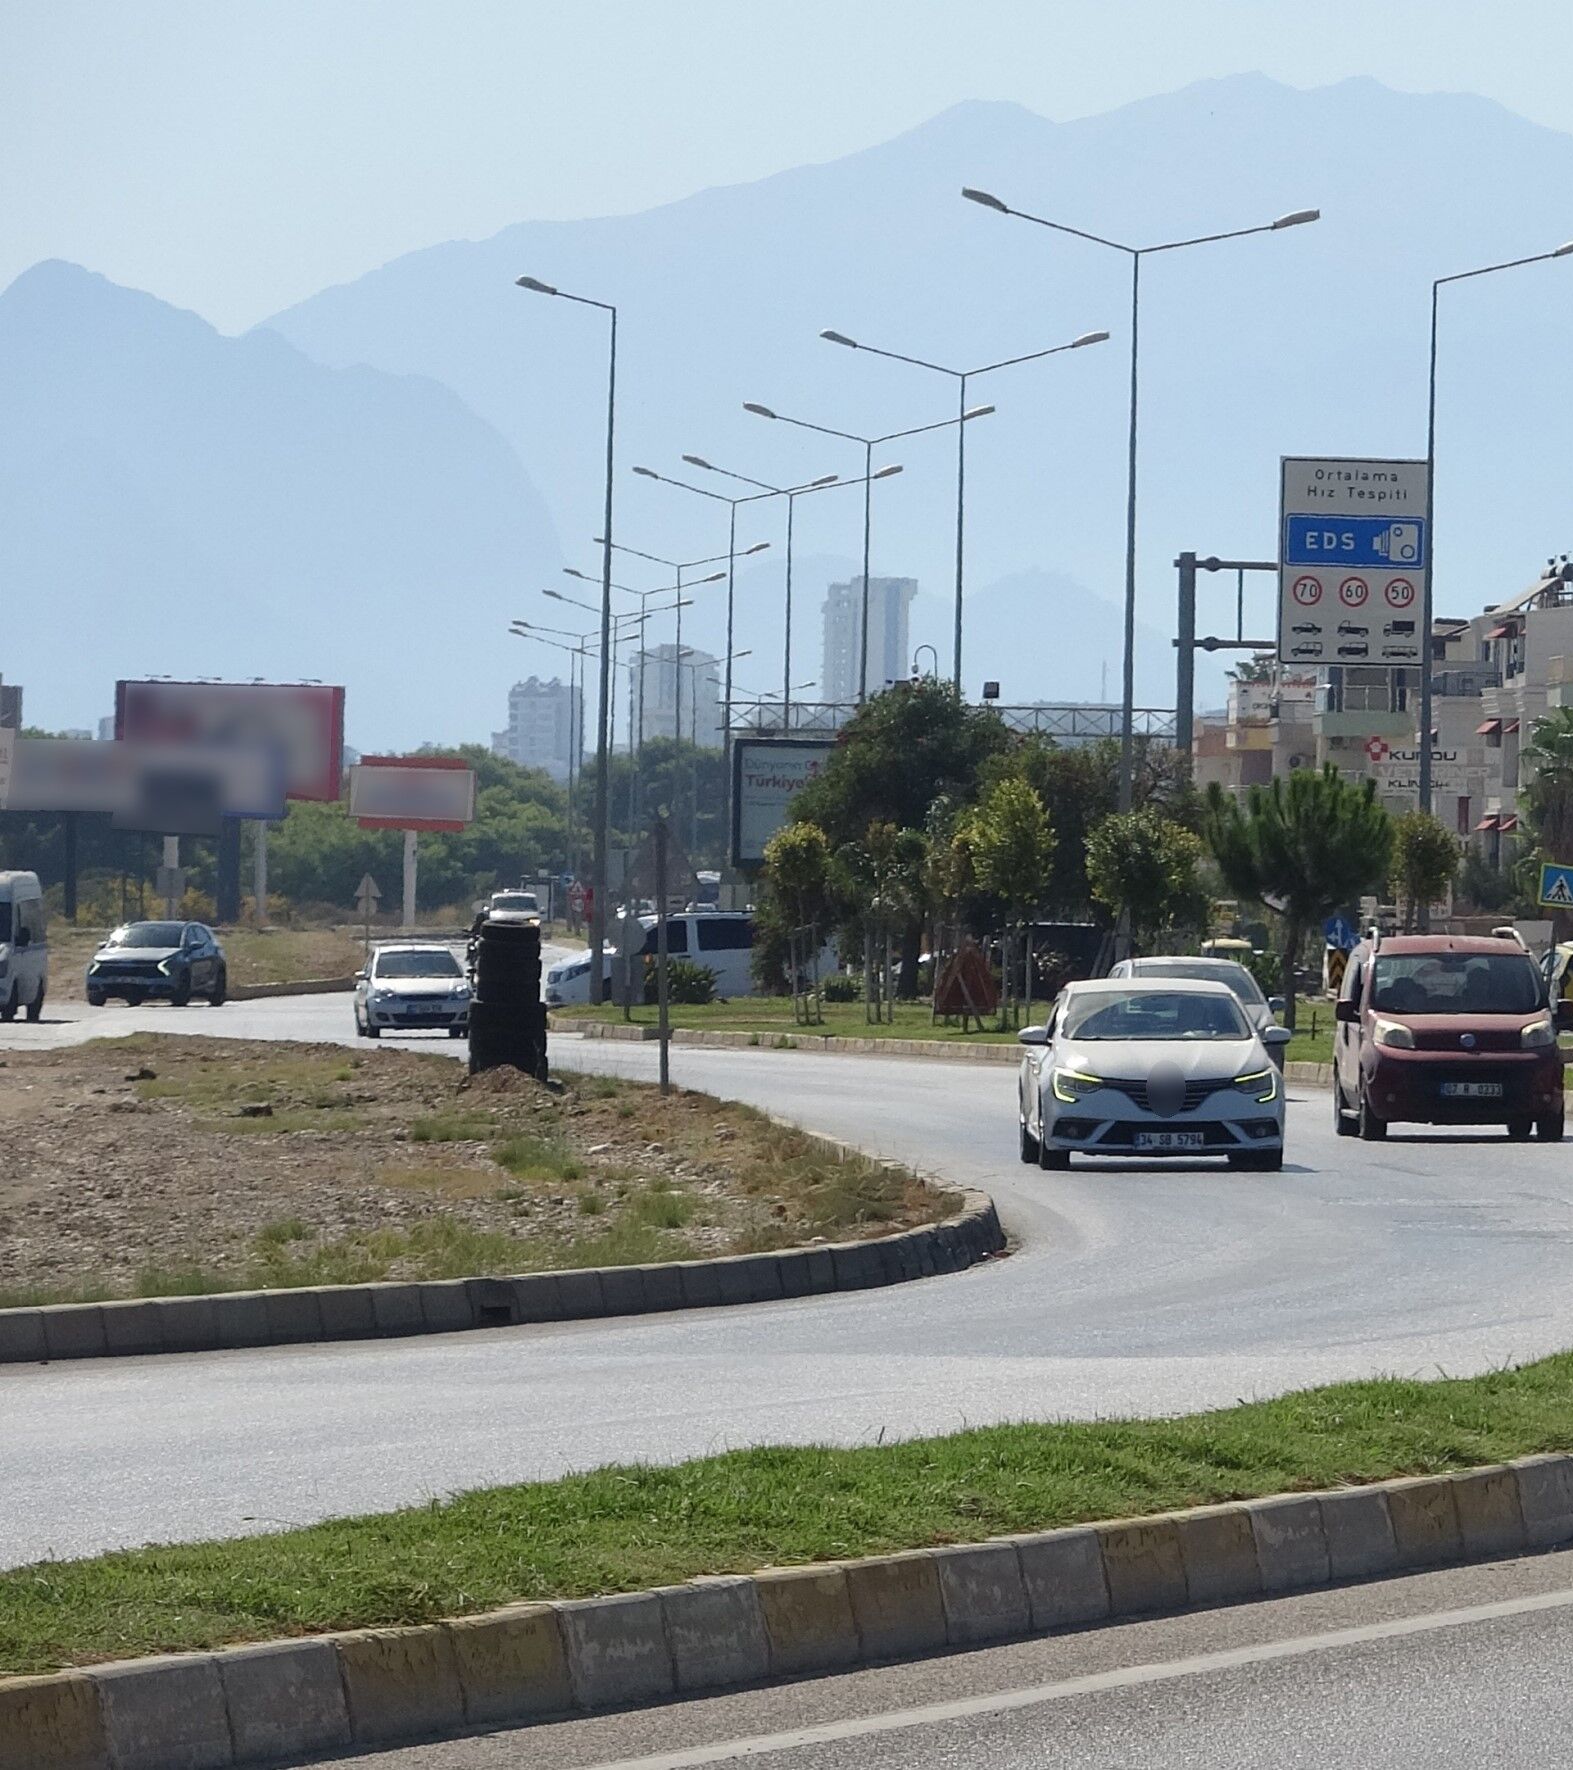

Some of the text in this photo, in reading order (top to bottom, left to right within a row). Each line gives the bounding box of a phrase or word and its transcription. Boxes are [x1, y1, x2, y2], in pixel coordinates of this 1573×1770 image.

[1315, 469, 1398, 482] Ortalama
[1307, 486, 1407, 501] Hız Tespiti
[1305, 532, 1355, 550] EDS
[1298, 584, 1318, 598] 70
[1345, 585, 1363, 599] 60
[1391, 586, 1409, 600] 50
[1140, 1133, 1152, 1146] 34
[1177, 1133, 1203, 1146] 5794
